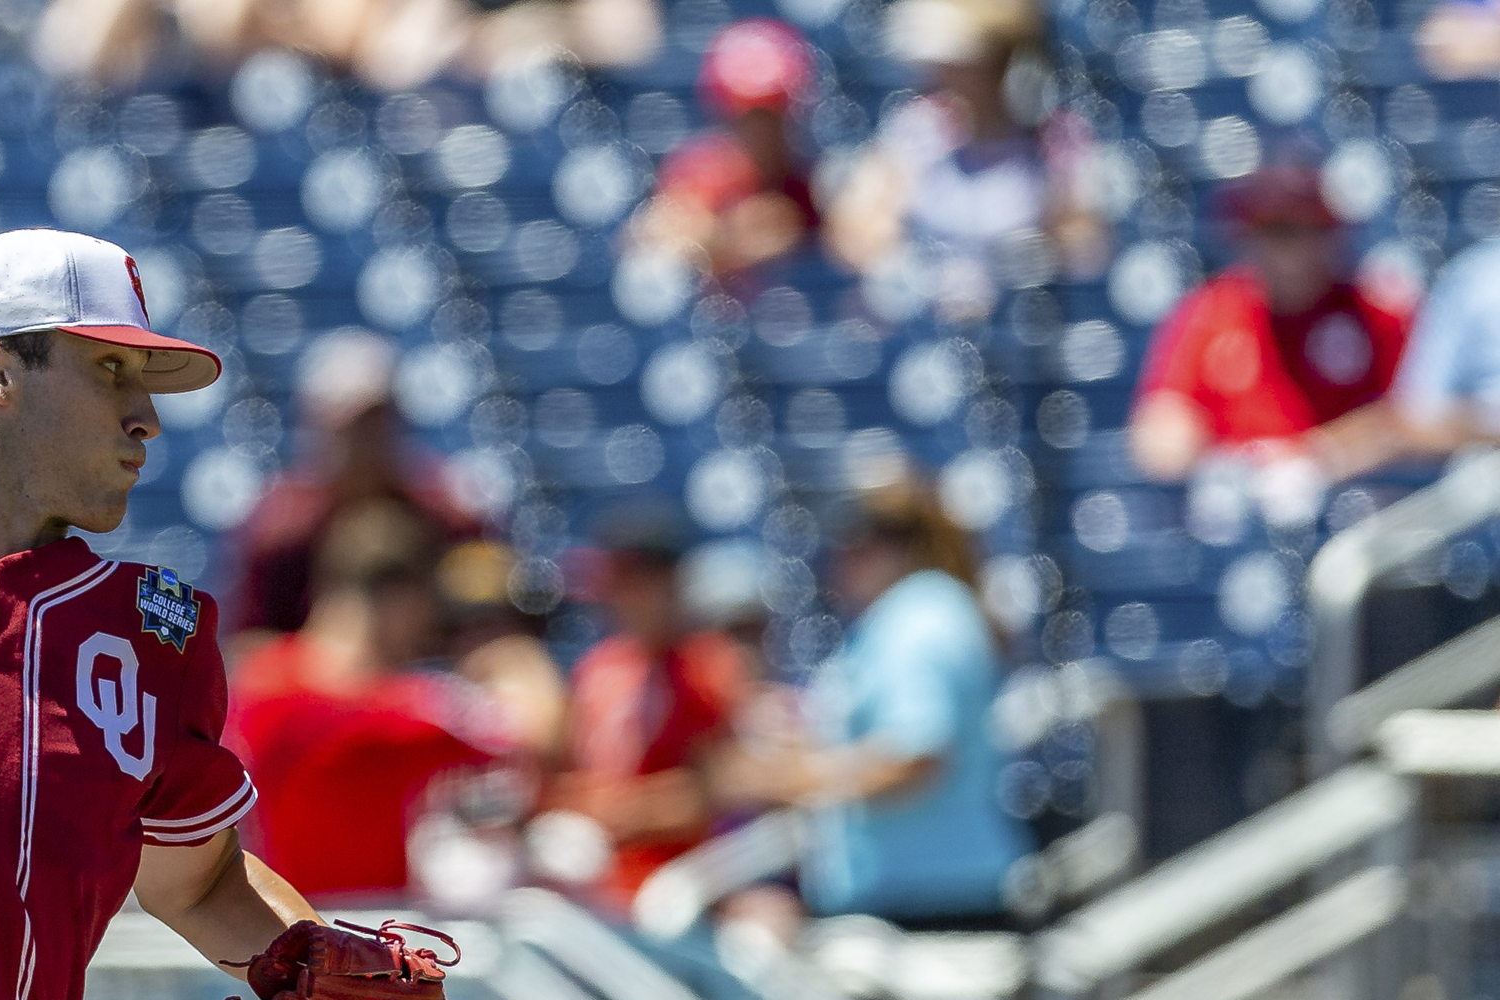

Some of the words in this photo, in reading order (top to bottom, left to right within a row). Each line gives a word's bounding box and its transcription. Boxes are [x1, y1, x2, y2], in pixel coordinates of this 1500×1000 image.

[140, 598, 168, 619] WORLD
[167, 612, 195, 632] SERIES
[152, 593, 186, 616] COLLEGE
[75, 631, 157, 782] OU
